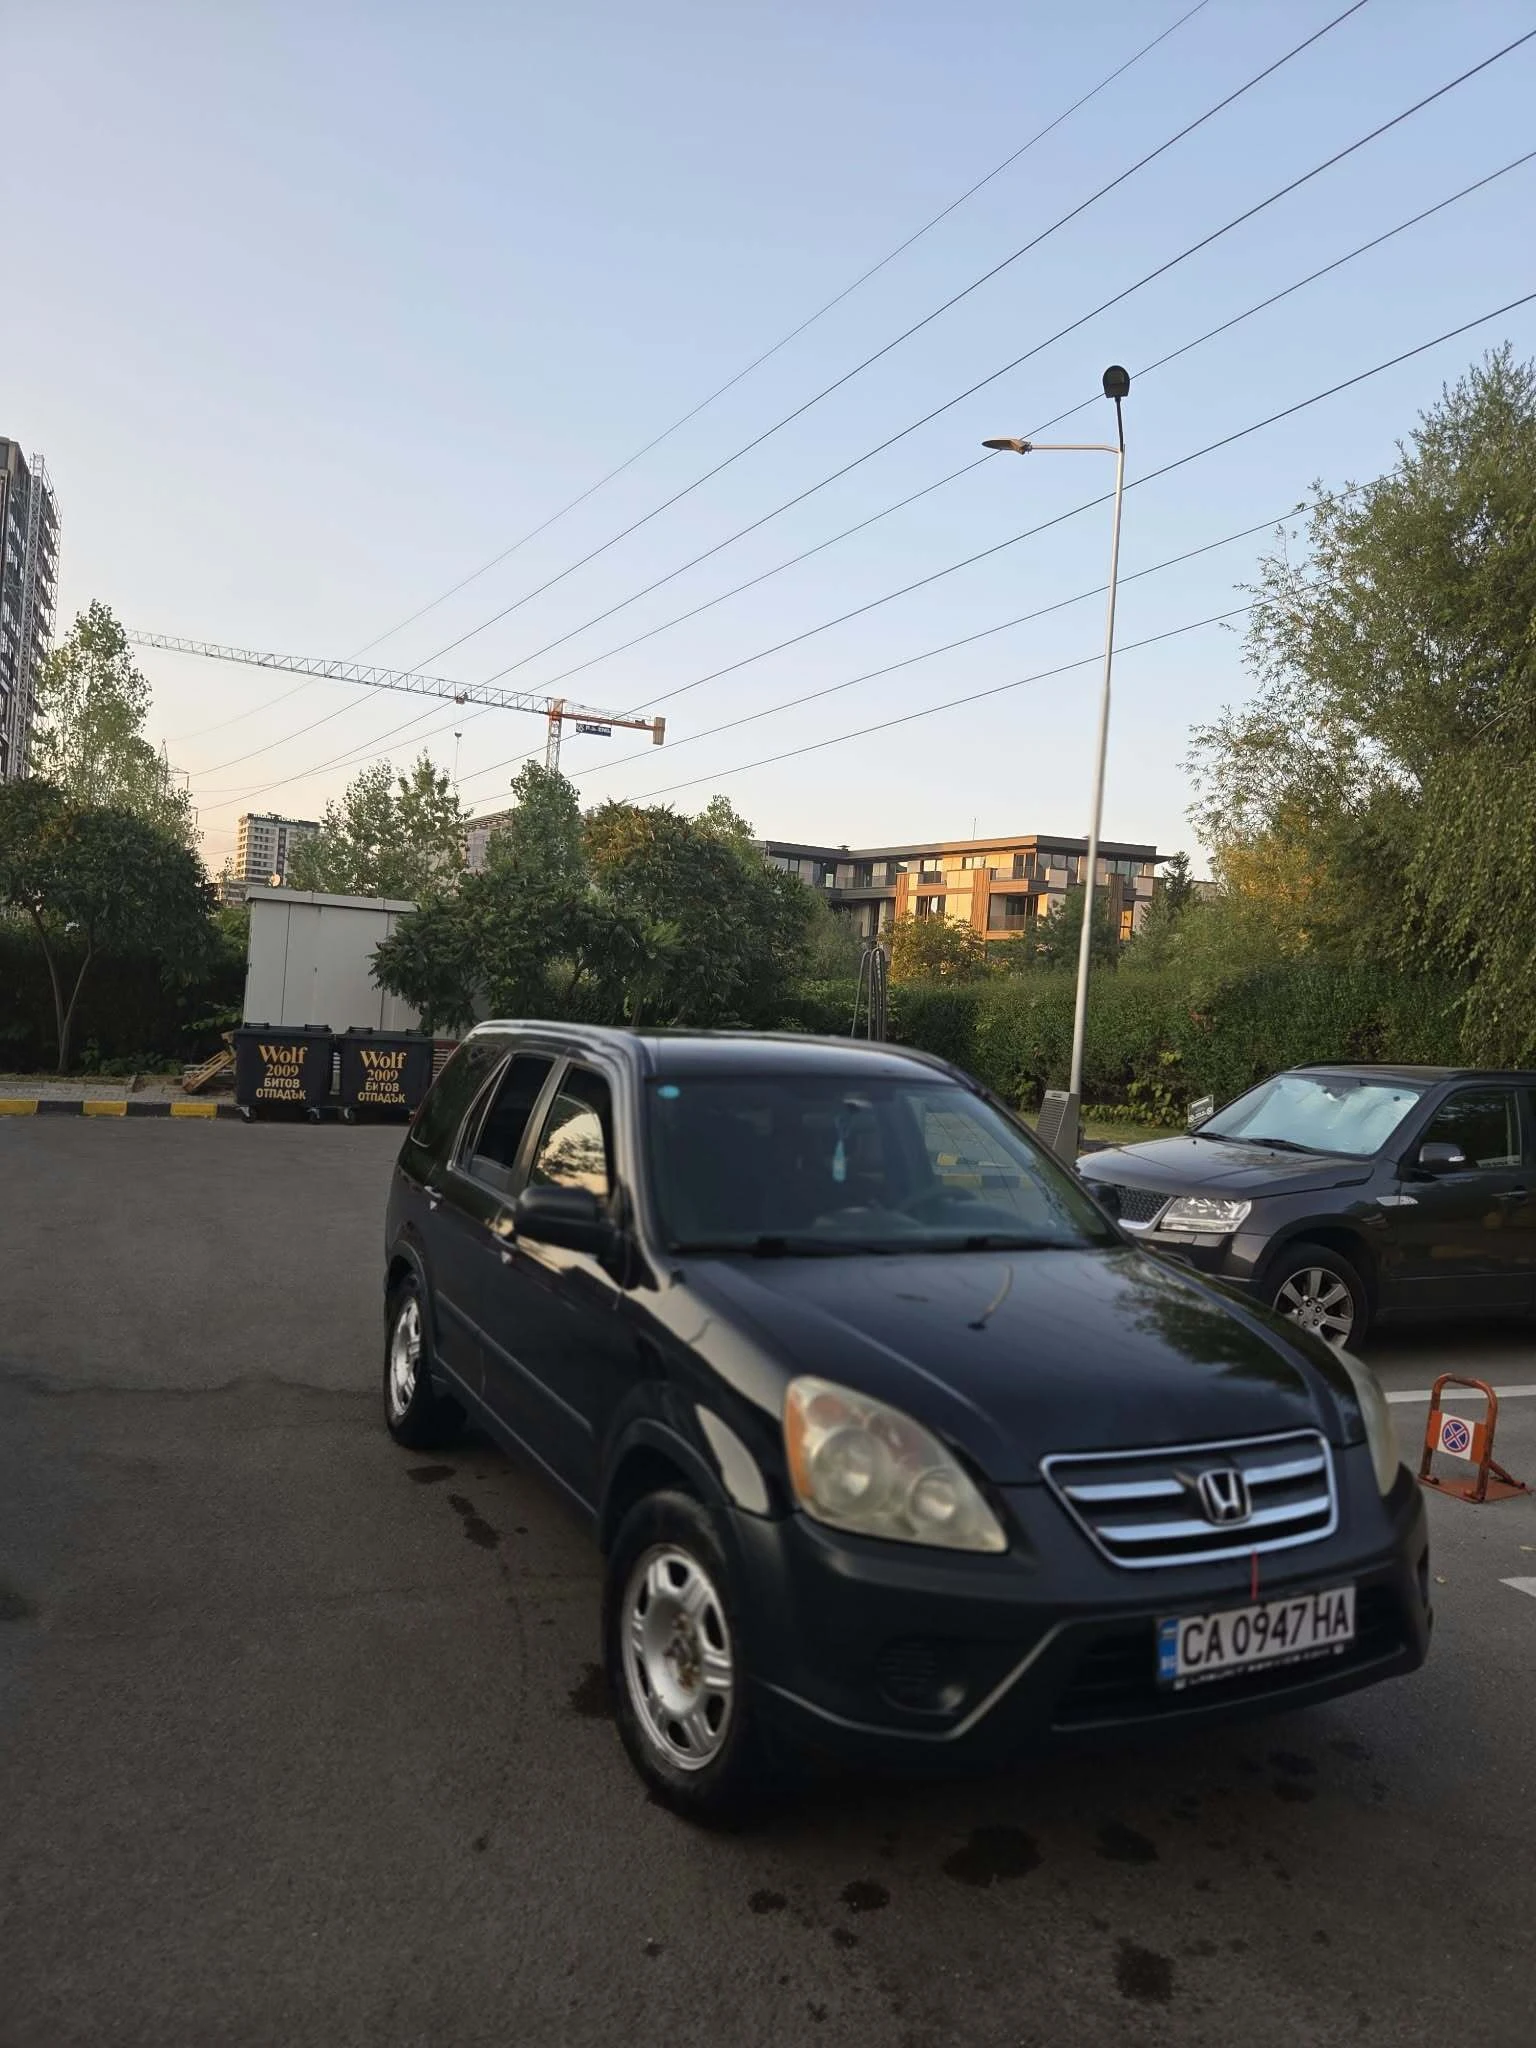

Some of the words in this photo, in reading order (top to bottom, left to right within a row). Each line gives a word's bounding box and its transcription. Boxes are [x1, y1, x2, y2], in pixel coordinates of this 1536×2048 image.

[258, 1044, 308, 1064] Wolf
[359, 1050, 407, 1069] Wolf
[265, 1063, 299, 1077] 2009
[366, 1069, 399, 1082] 2009
[263, 1077, 301, 1089] БИТОВ
[365, 1081, 400, 1093] БИТОВ
[255, 1087, 307, 1101] ОТПАДЪК
[357, 1091, 406, 1104] ОТПАДЪК
[1182, 1620, 1224, 1666] CA
[1232, 1602, 1309, 1656] 0947
[1312, 1593, 1350, 1641] HA
